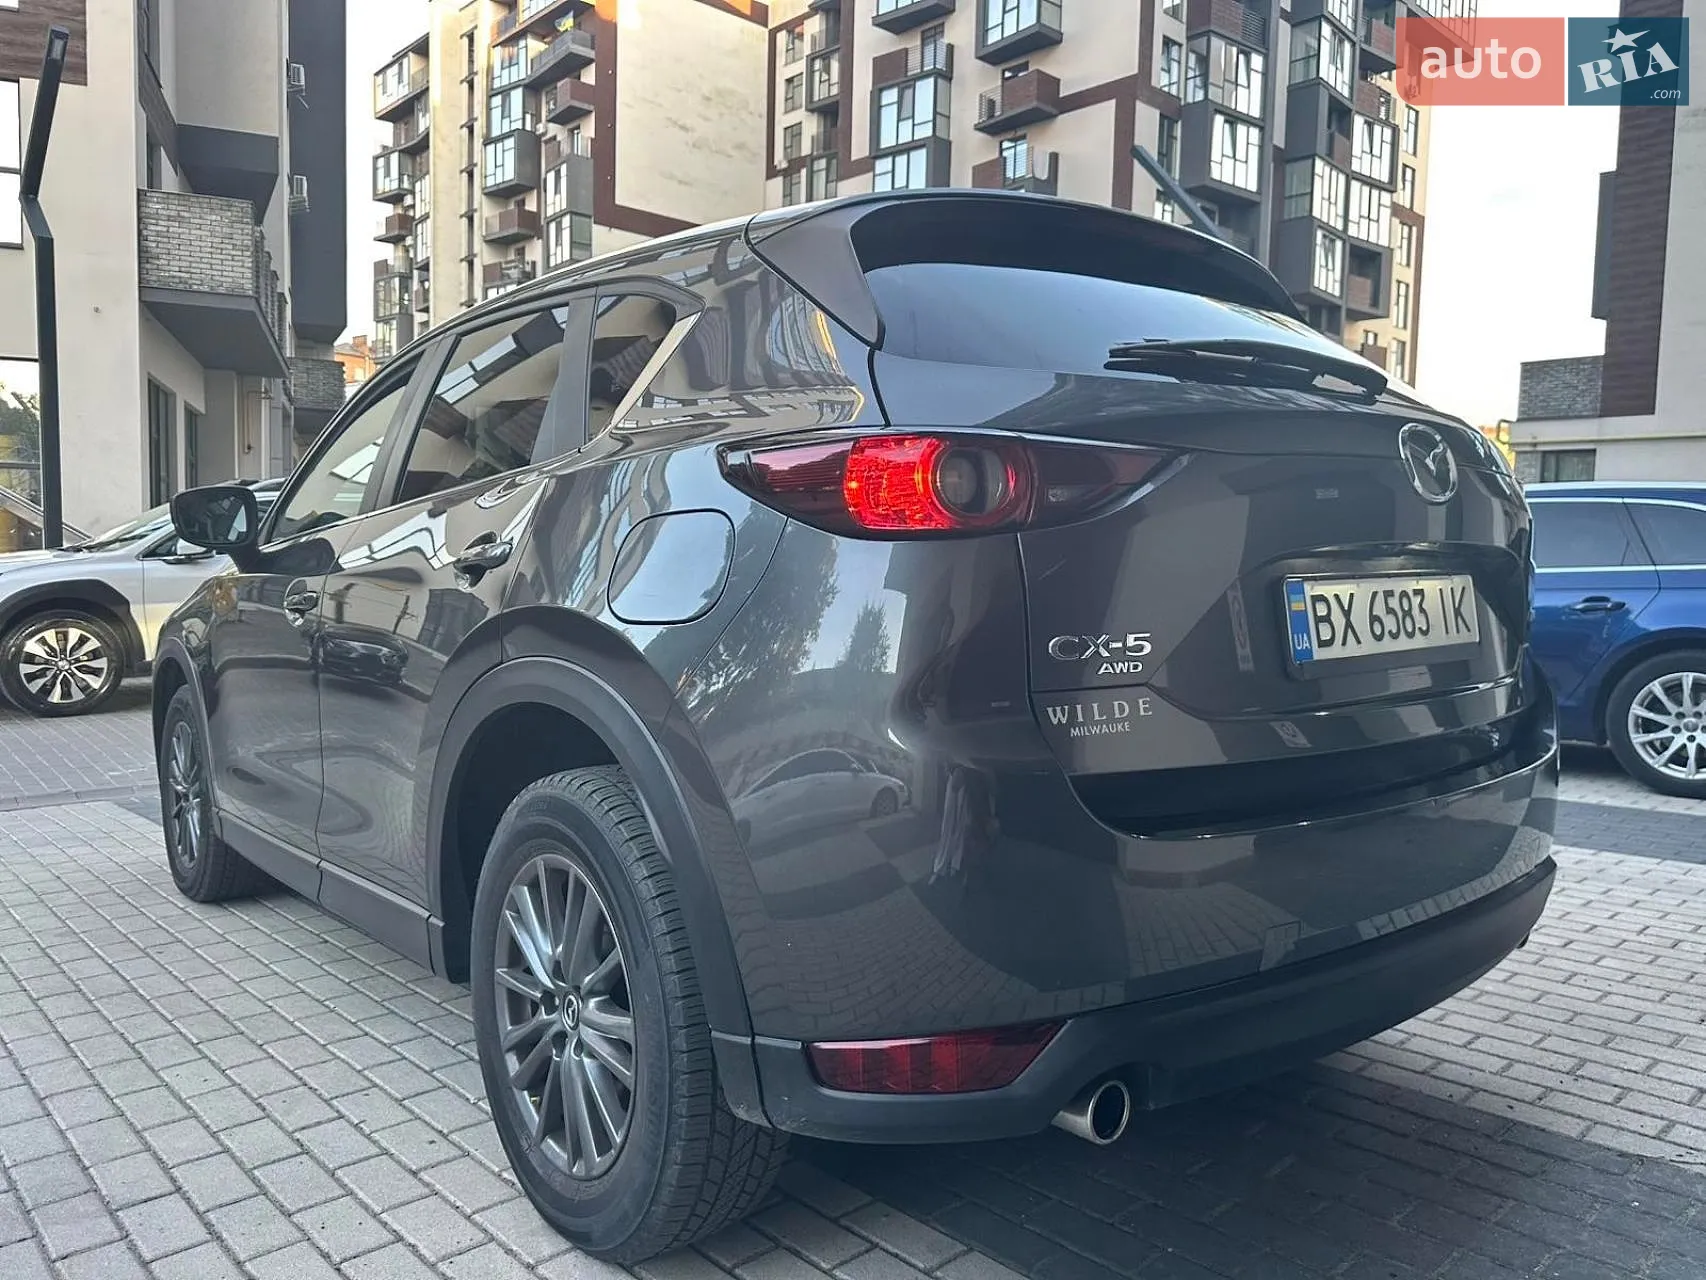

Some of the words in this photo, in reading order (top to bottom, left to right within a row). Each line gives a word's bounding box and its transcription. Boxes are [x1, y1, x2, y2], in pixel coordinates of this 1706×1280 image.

[1310, 592, 1362, 649] BX
[1368, 588, 1431, 642] 6583
[1439, 586, 1471, 635] IK
[1048, 633, 1152, 660] CX-5
[1294, 633, 1311, 650] UA
[1097, 661, 1143, 675] AWD
[1046, 697, 1153, 725] WILDE
